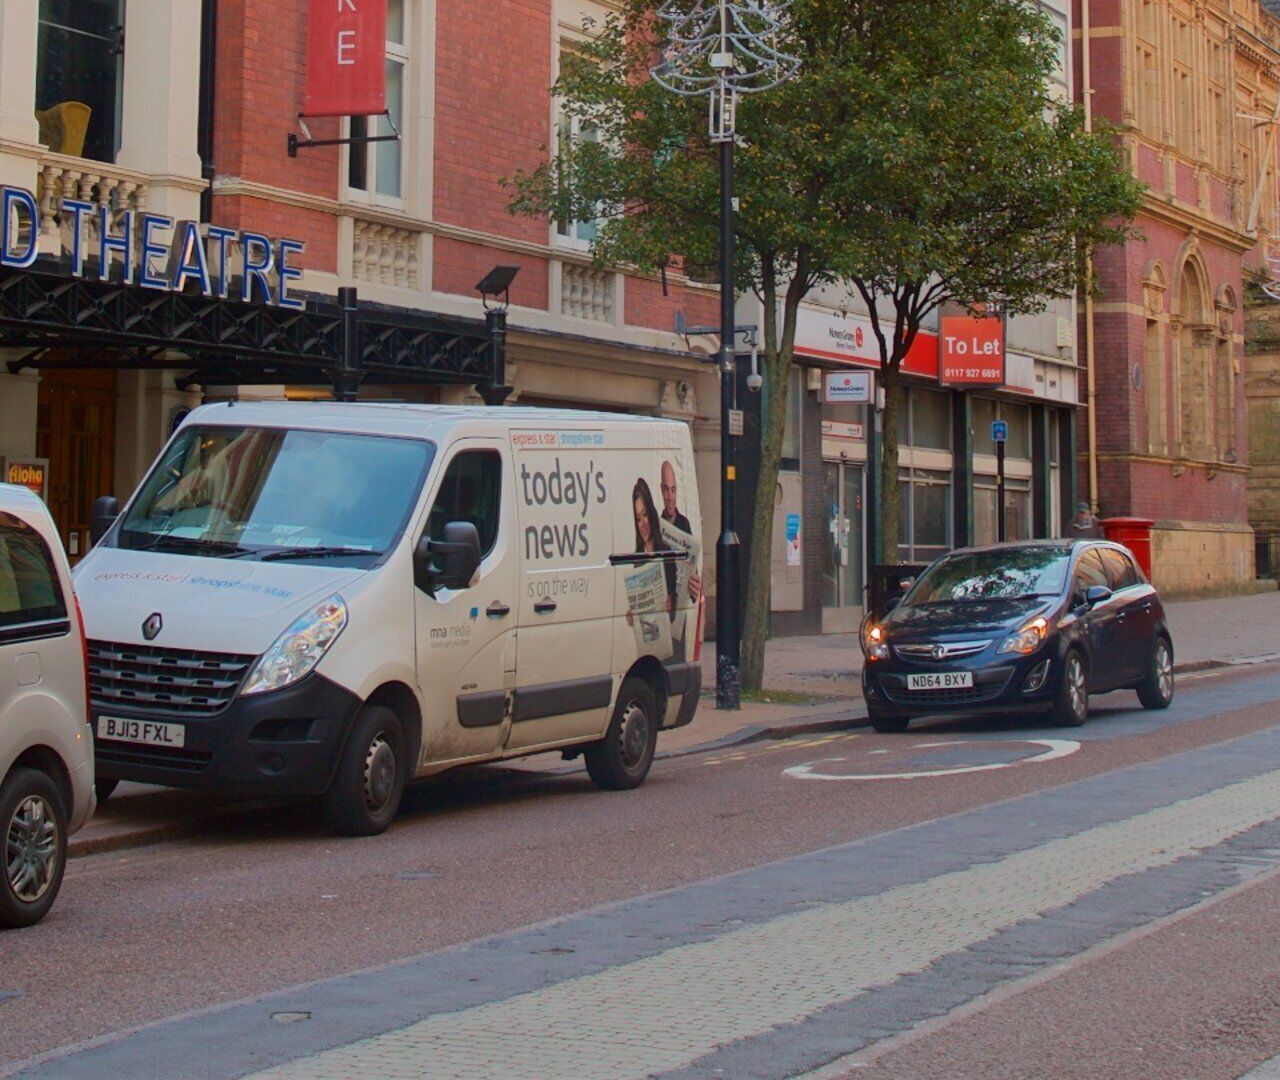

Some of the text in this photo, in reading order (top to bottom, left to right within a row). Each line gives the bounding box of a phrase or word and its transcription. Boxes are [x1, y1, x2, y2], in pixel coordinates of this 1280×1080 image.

[60, 197, 307, 310] THEATRE
[944, 336, 1000, 355] To Let
[944, 369, 1000, 378] 0117 927 6691
[512, 433, 537, 445] express
[544, 433, 556, 445] star
[8, 465, 43, 484] Aloha
[521, 457, 607, 518] today's
[524, 522, 589, 560] news
[94, 571, 140, 581] express
[154, 572, 182, 583] star
[189, 576, 293, 598] shropshire star
[528, 575, 590, 598] is on the way
[912, 674, 966, 687] ND64 BXY
[106, 719, 173, 742] BJ13 FXL
